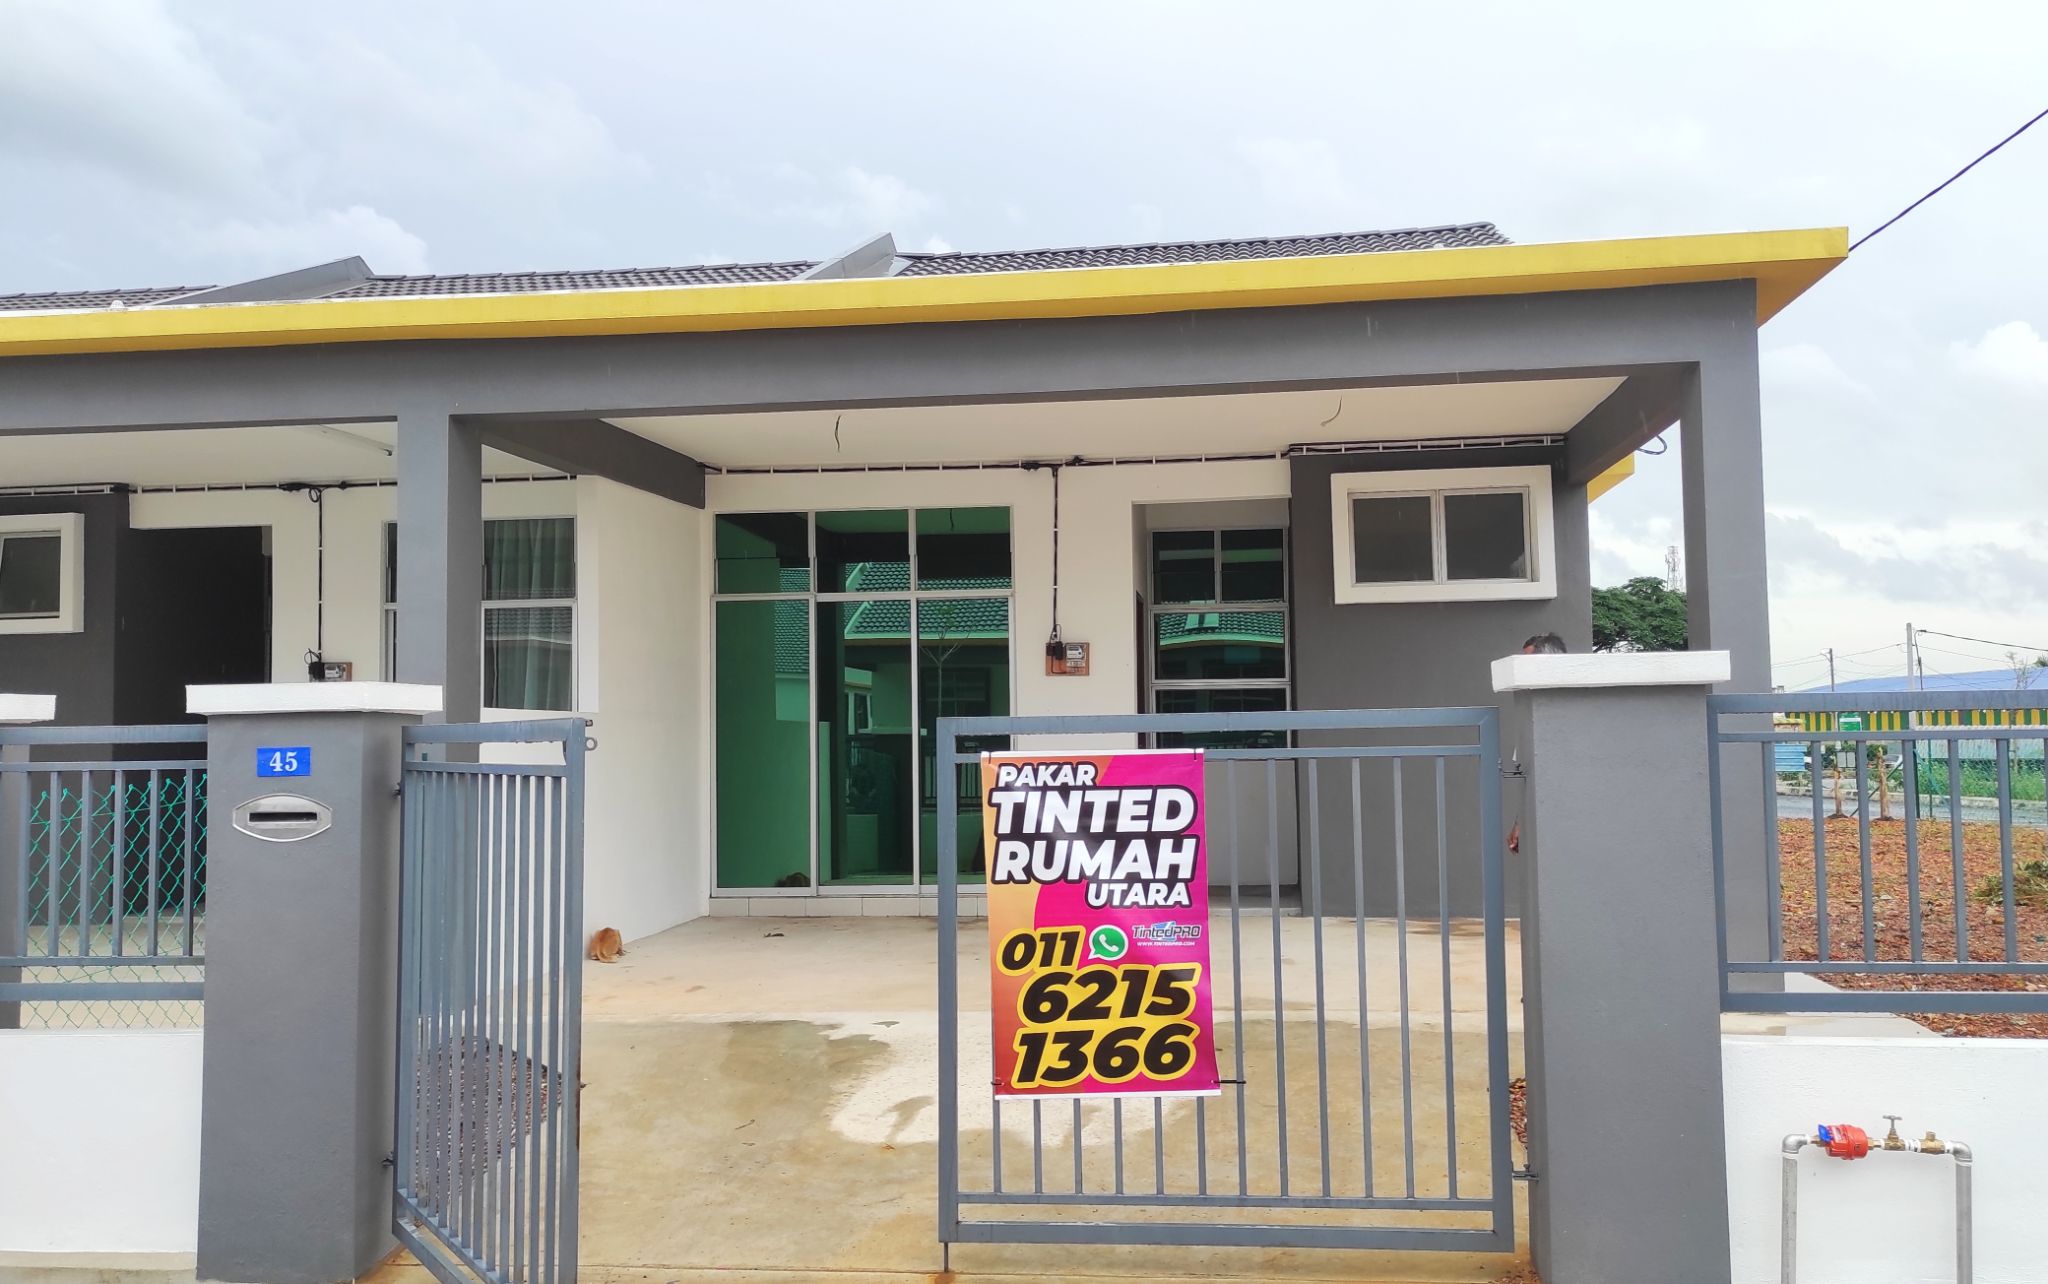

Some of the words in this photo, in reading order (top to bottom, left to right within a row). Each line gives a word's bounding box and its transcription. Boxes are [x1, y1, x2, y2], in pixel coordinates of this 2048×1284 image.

[269, 751, 298, 772] 45
[998, 764, 1096, 787] PAKAR
[990, 788, 1195, 834] TINTED
[996, 838, 1196, 881] RUMAH
[1088, 883, 1190, 906] UTARA
[1001, 931, 1080, 970] 011
[1132, 925, 1201, 939] TintedPRO
[1022, 968, 1195, 1024] 6215
[1017, 1023, 1195, 1083] 1366
